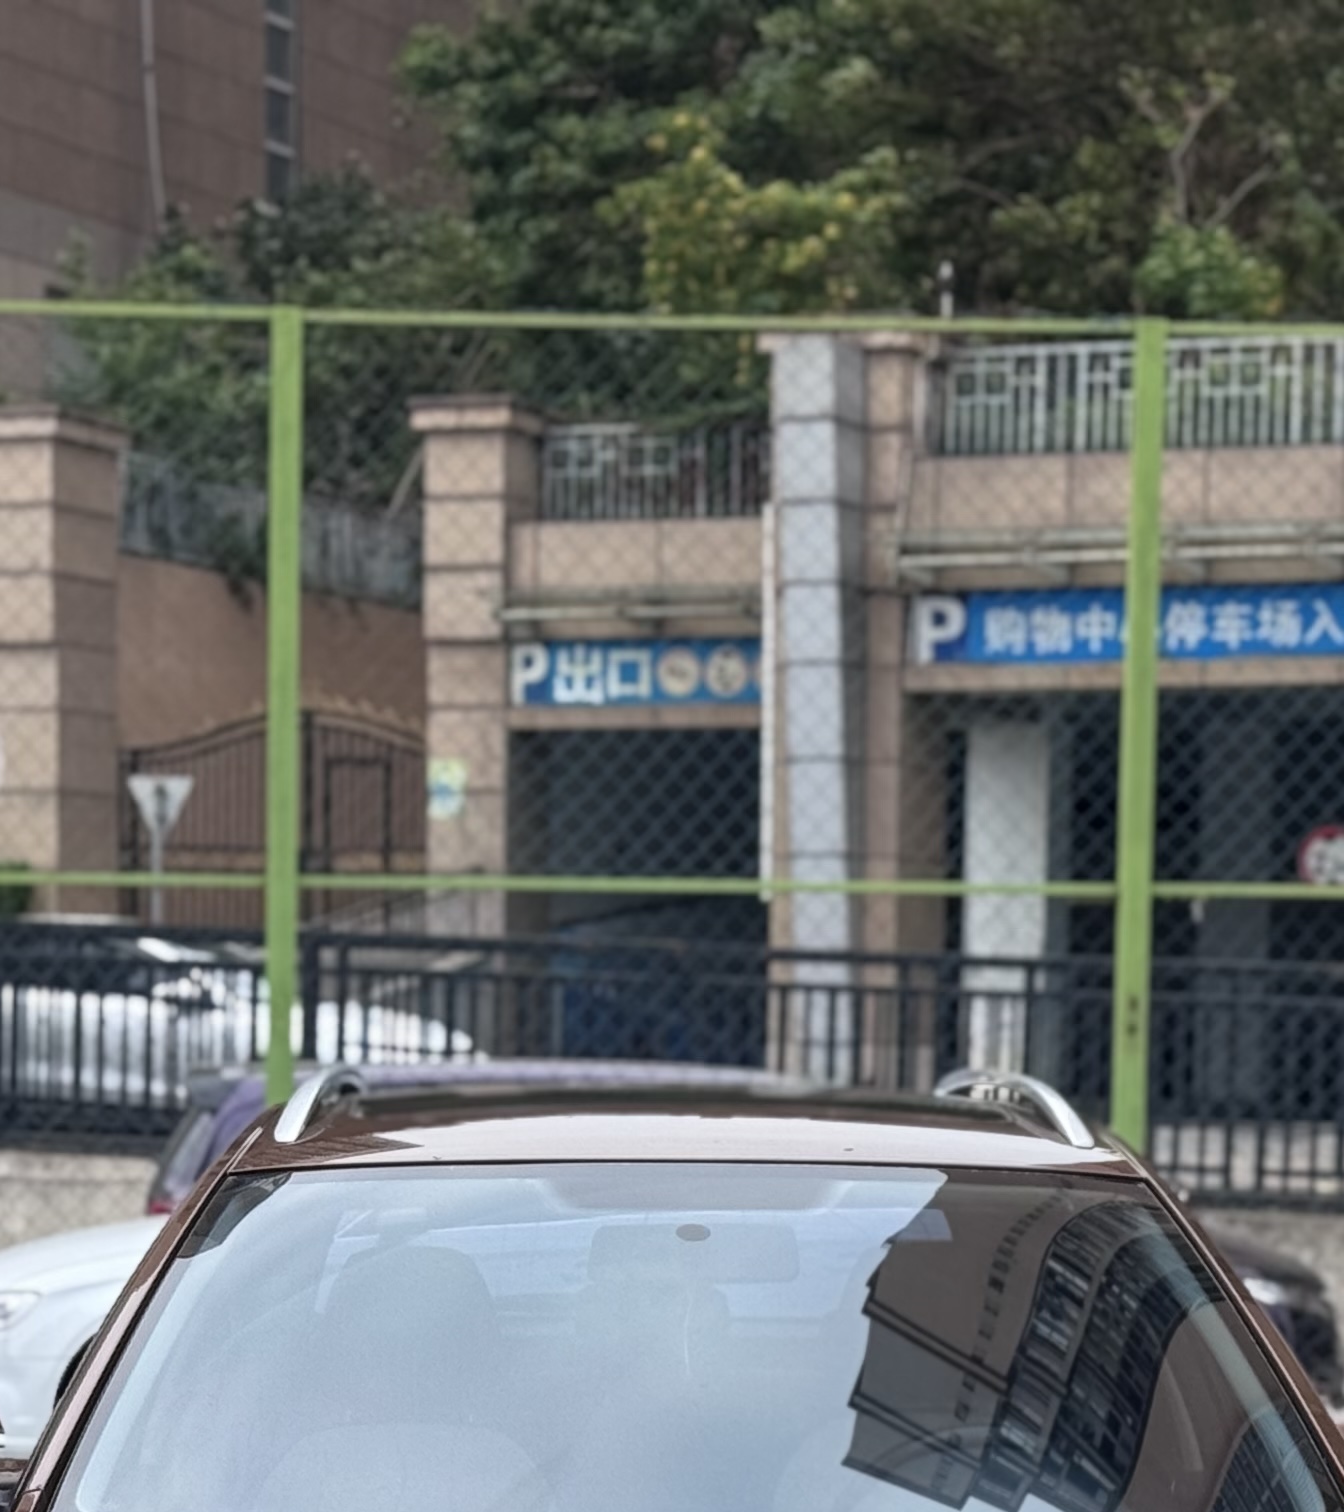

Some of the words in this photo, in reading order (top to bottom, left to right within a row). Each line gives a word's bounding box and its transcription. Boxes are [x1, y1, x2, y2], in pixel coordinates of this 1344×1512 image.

[916, 597, 967, 664] P
[511, 643, 549, 705] P
[552, 643, 652, 705] 出口
